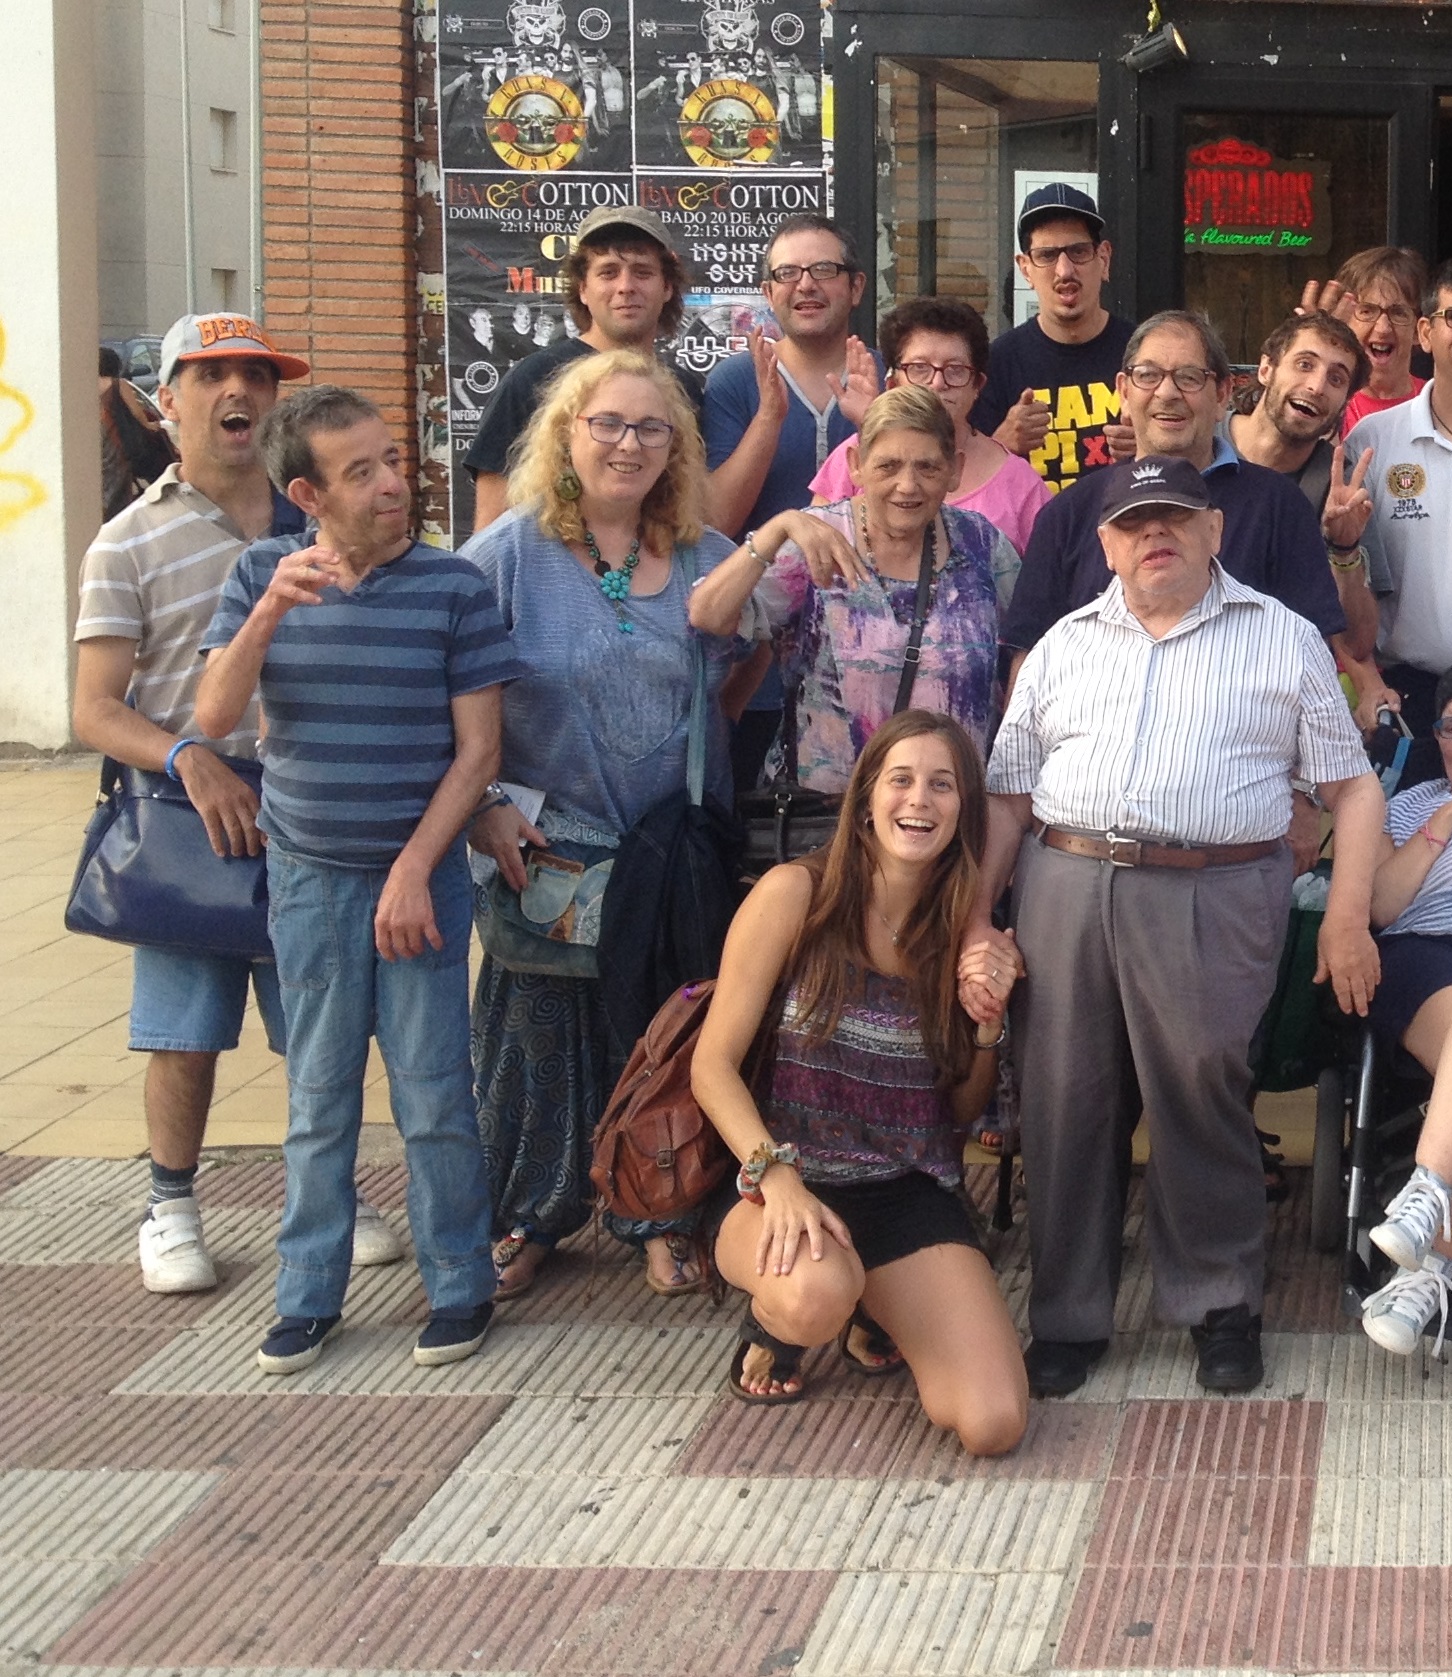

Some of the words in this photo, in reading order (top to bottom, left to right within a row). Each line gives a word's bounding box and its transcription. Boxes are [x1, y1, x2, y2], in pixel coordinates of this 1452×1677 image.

[520, 181, 630, 207] COTTON
[713, 184, 820, 209] COTTON
[449, 207, 522, 220] DOMINGO
[528, 209, 541, 220] 14
[545, 209, 566, 221] DE
[661, 211, 707, 224] BADO
[710, 213, 727, 224] 20
[730, 213, 751, 225] DE
[500, 221, 531, 233] 22:15
[534, 222, 580, 233] HORAS
[684, 225, 720, 237] 22:15
[1277, 231, 1313, 248] Beer
[691, 286, 711, 294] UFO
[713, 286, 764, 294] COVERBA
